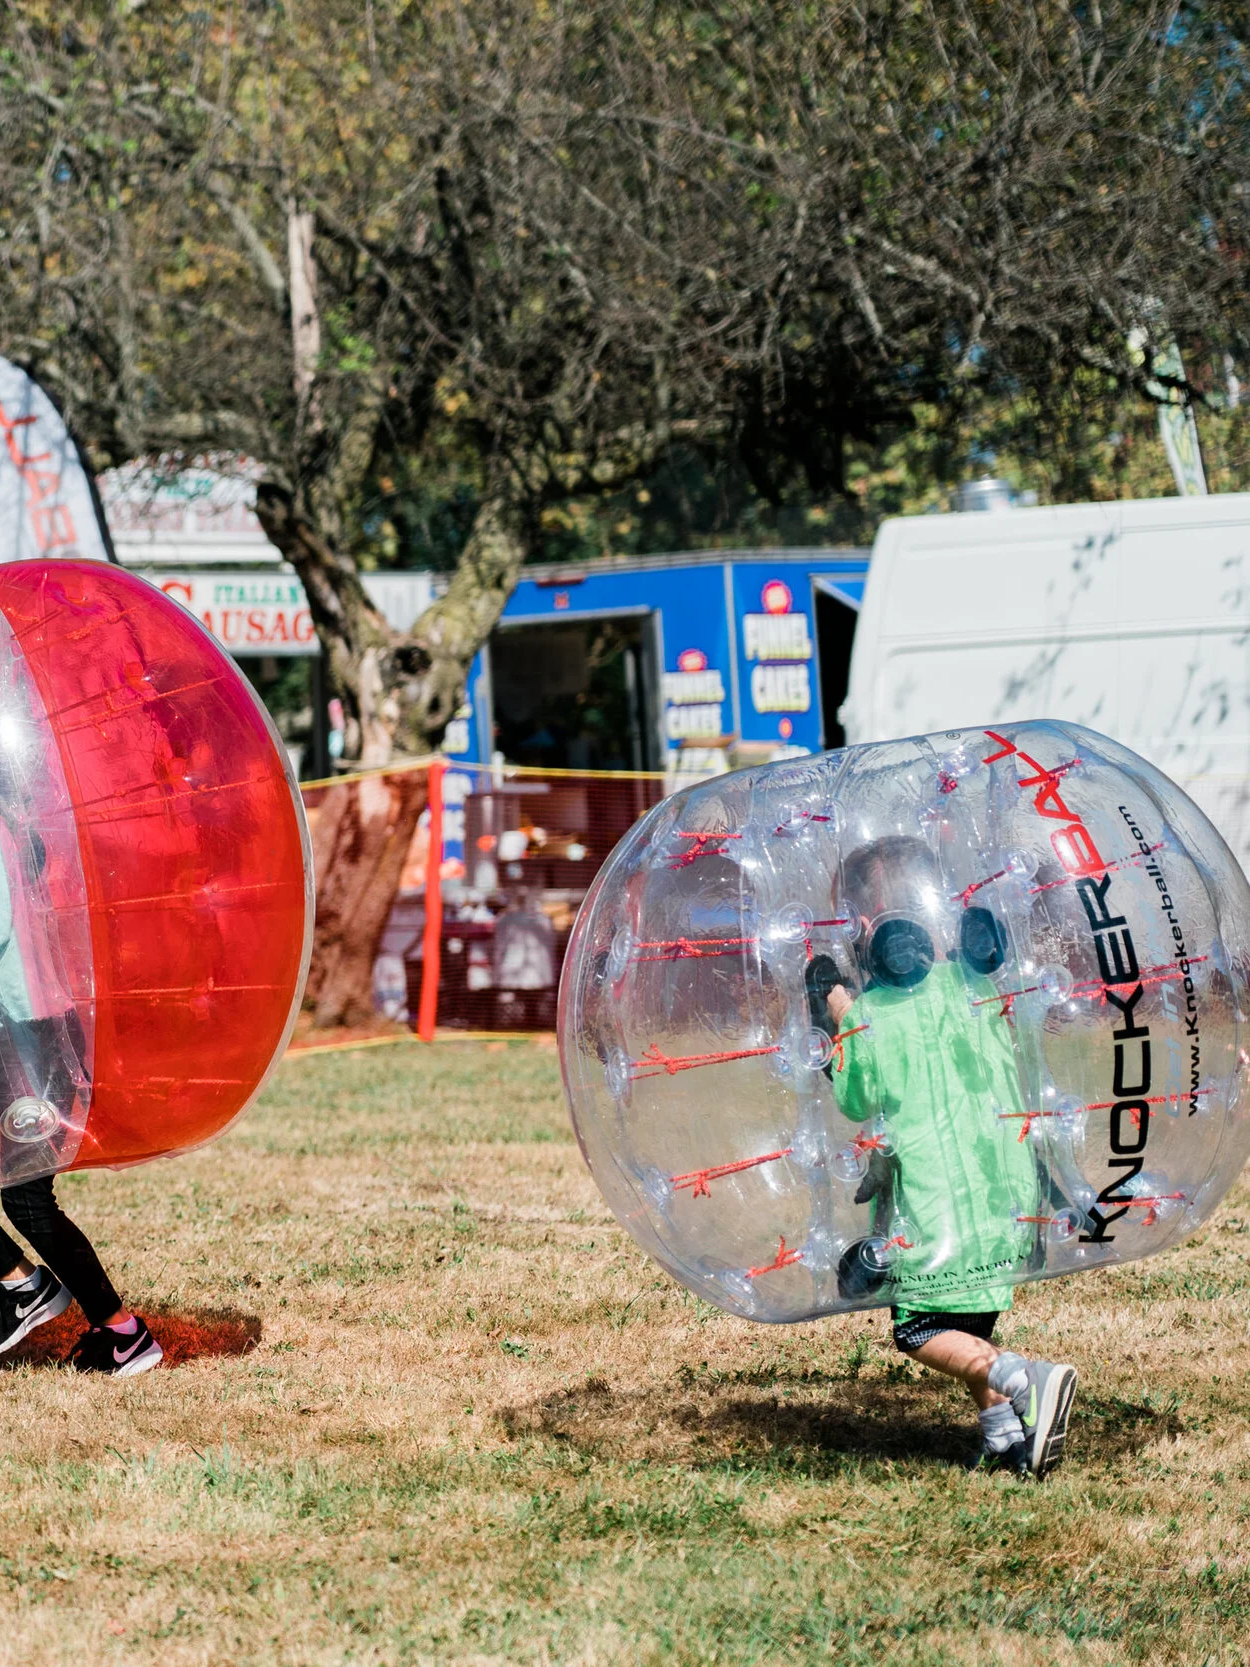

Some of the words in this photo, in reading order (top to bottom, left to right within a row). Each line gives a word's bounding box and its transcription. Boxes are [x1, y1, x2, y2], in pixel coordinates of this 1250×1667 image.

[213, 584, 302, 605] ITALIAN
[1118, 805, 1200, 1117] www.Knockerball.com
[943, 1271, 958, 1279] IN
[965, 1254, 1026, 1275] AMERICA
